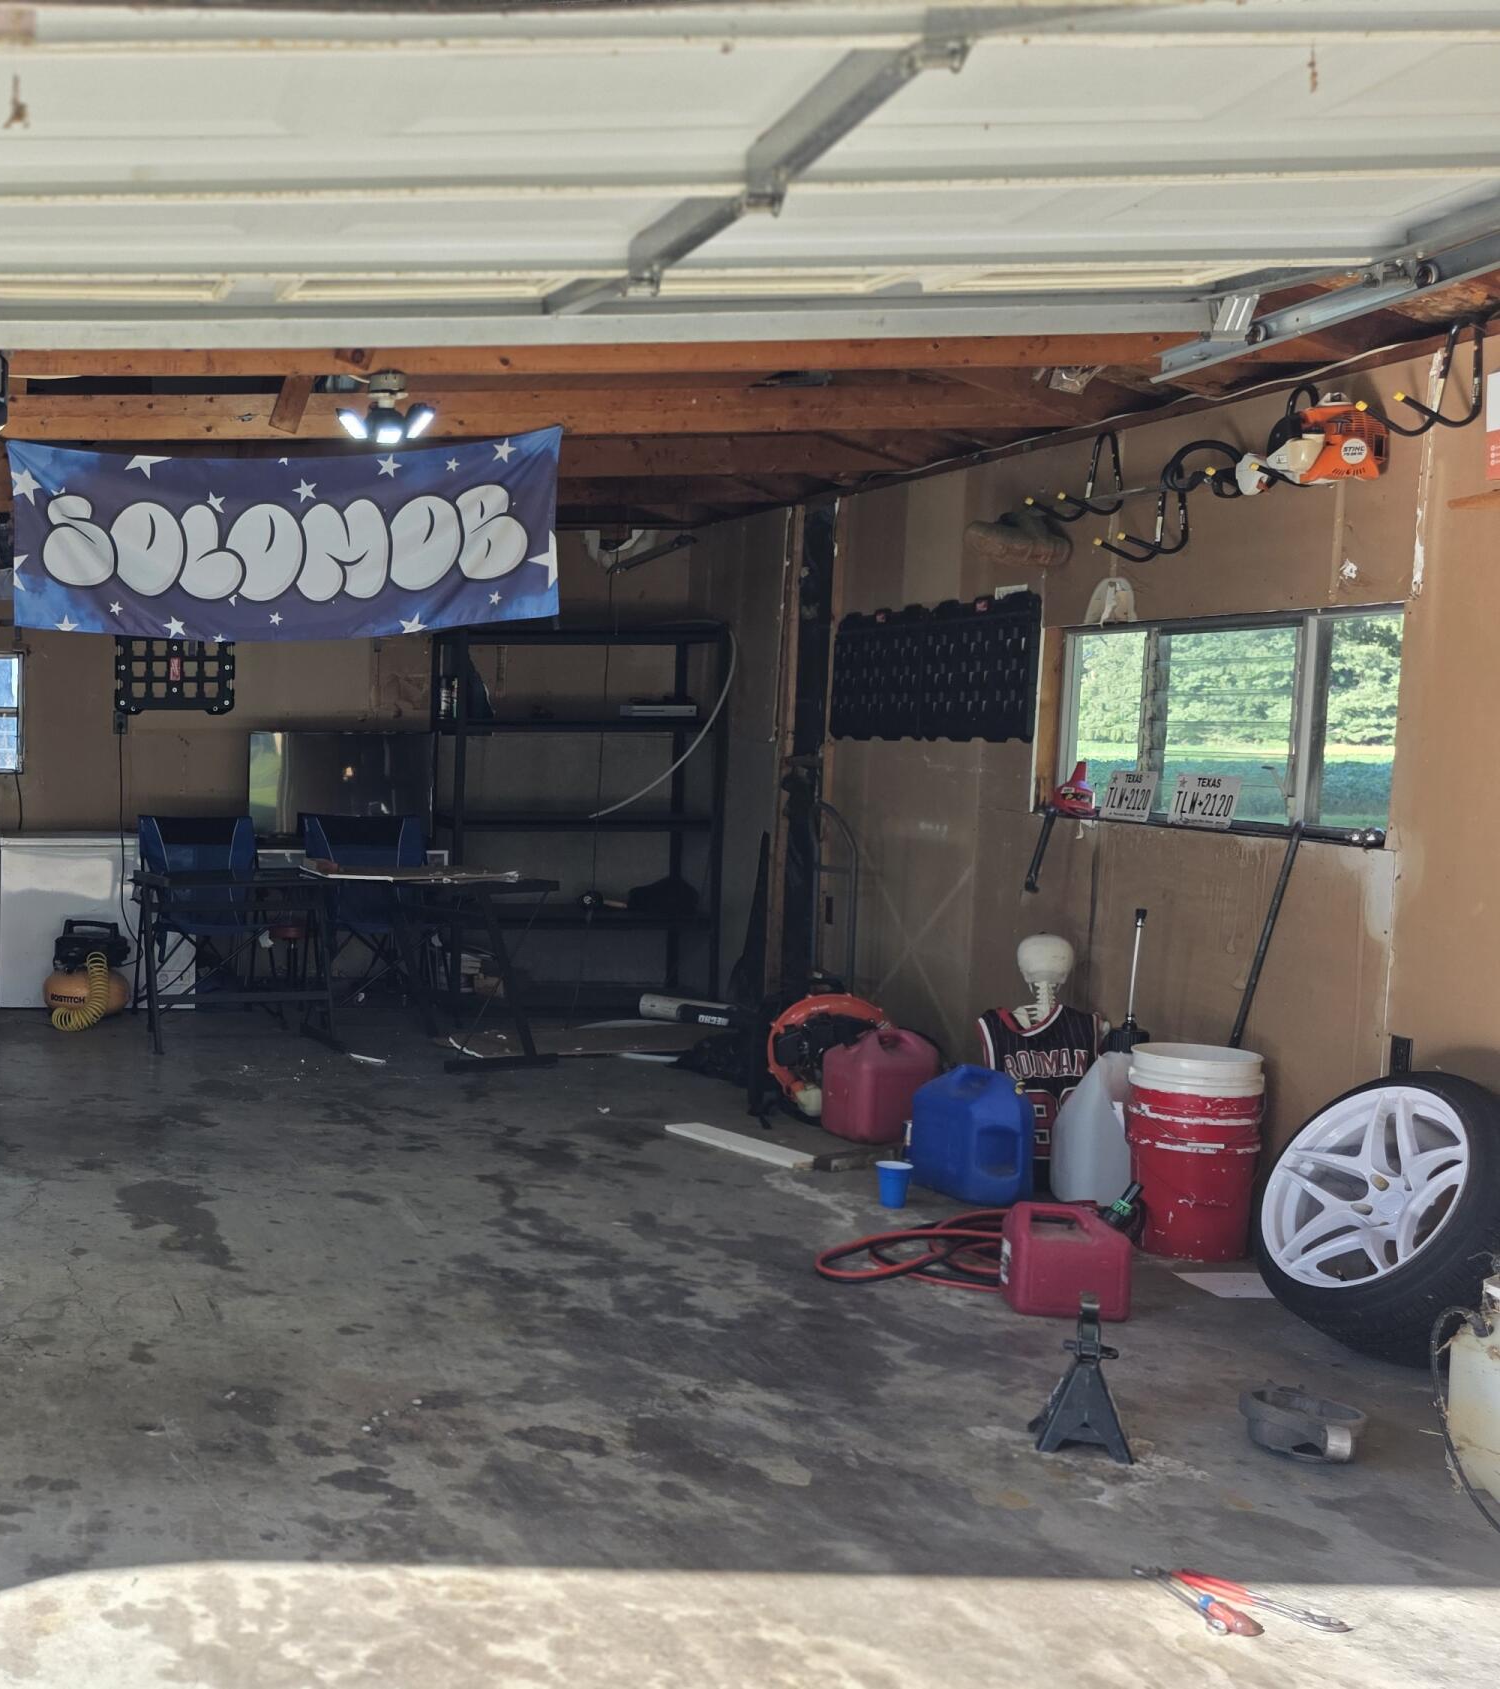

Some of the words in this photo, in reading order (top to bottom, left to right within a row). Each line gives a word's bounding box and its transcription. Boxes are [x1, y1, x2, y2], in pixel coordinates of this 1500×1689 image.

[40, 482, 530, 603] SOLOMOB
[1125, 774, 1143, 784] TEXAS
[1197, 777, 1222, 788] TEXAS
